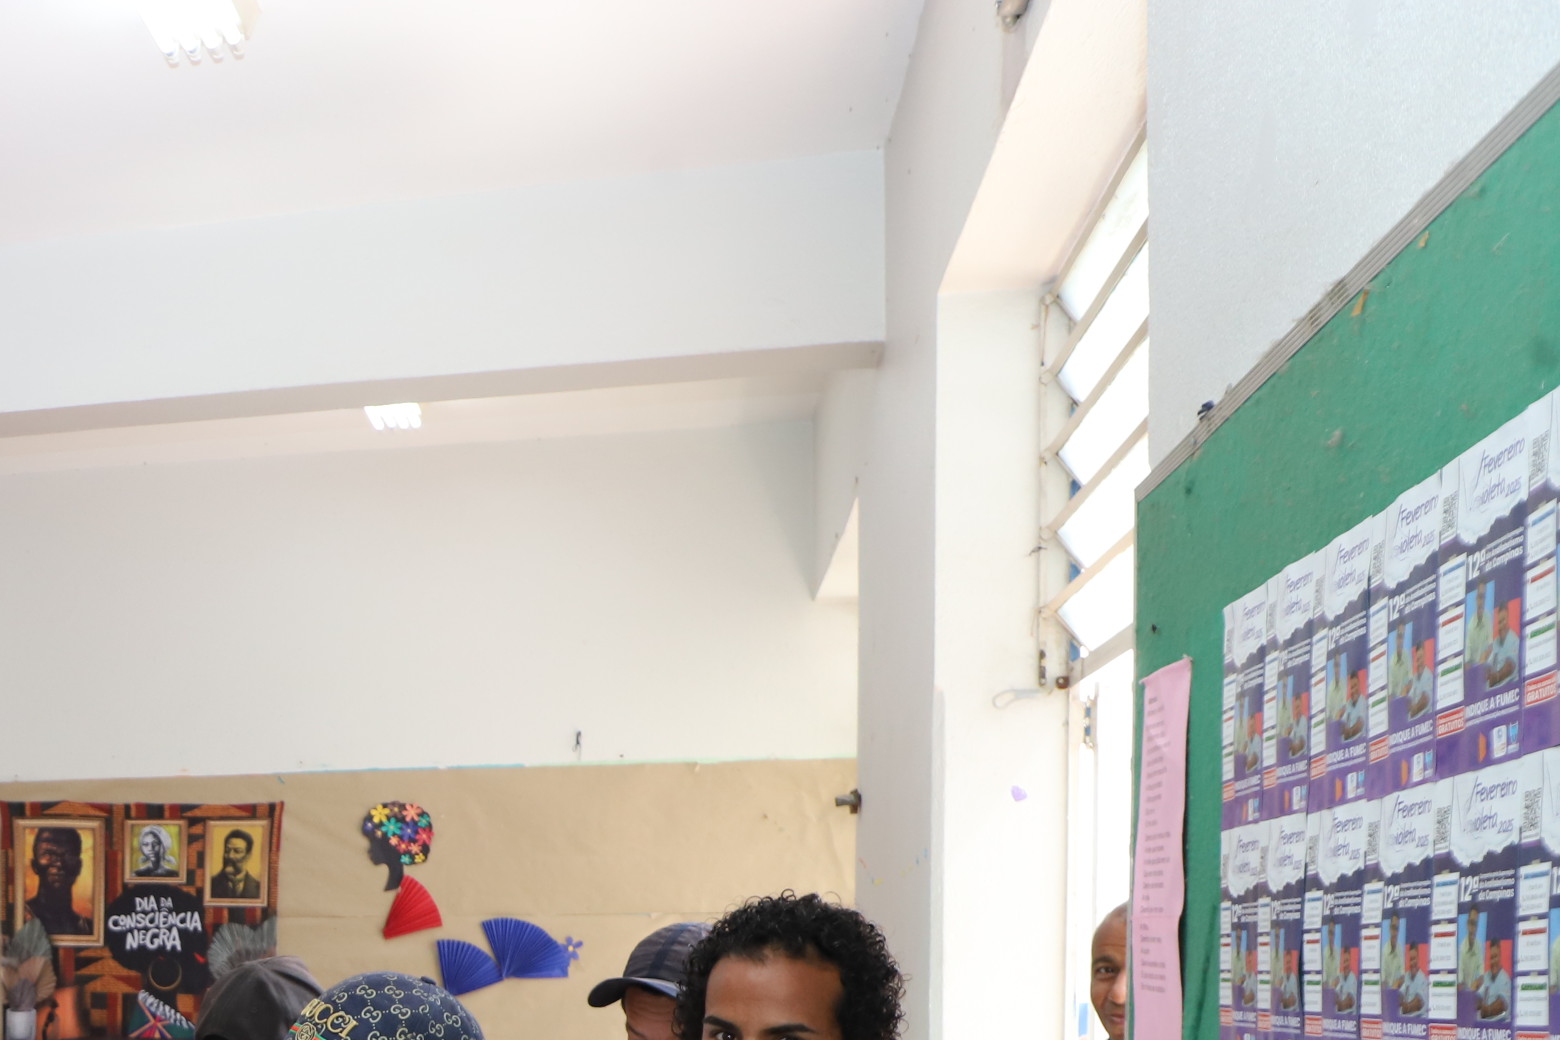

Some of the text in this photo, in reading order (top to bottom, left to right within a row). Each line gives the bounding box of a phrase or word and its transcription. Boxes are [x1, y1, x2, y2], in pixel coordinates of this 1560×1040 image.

[1482, 437, 1525, 474] Fevereiro
[1497, 688, 1520, 706] FUMEC
[1475, 778, 1517, 802] Fevereiro
[1398, 798, 1432, 818] Fevereiro
[135, 895, 173, 911] DIA DA
[1485, 887, 1515, 902] Campinas
[108, 908, 202, 931] CONSCIÊNCIA
[125, 926, 182, 952] NEGRA
[1407, 1023, 1426, 1036] FUMEC
[1481, 1029, 1489, 1040] A
